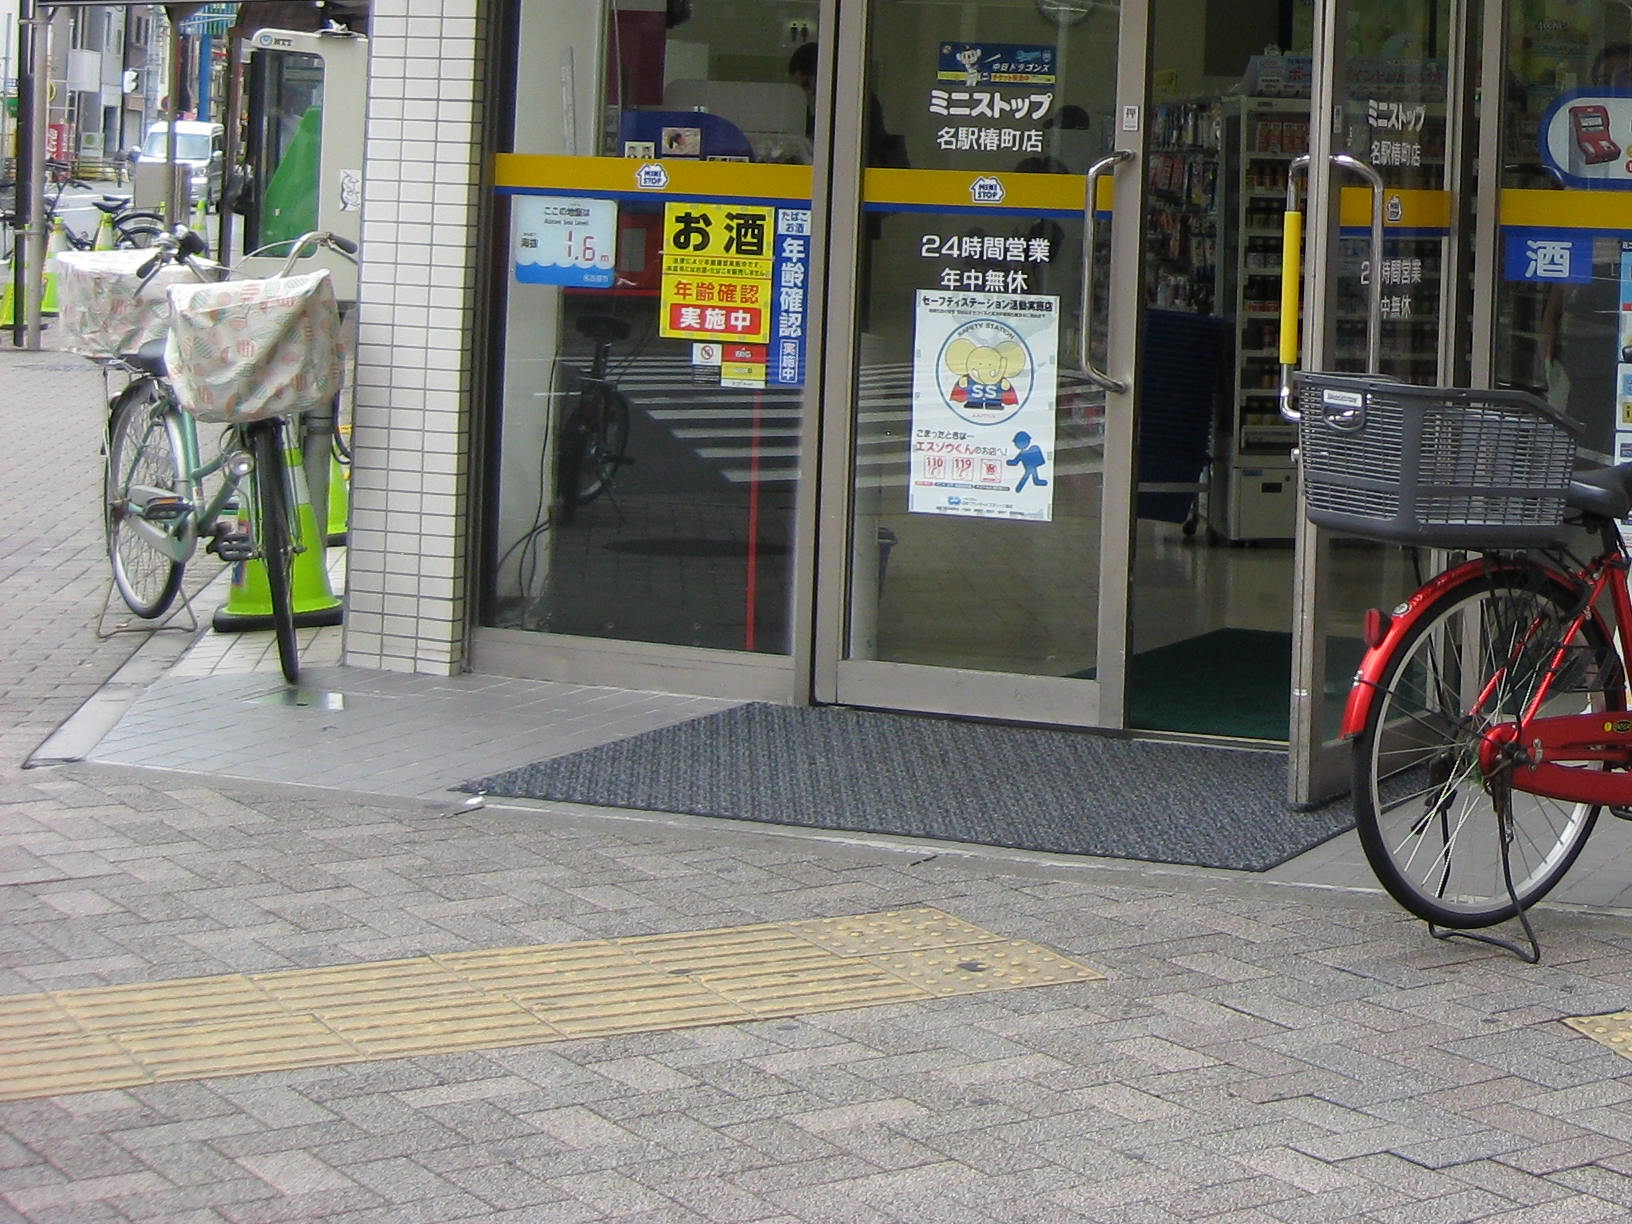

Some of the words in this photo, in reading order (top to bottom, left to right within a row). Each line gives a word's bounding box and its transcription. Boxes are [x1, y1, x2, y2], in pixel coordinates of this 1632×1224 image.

[929, 89, 1053, 120] ミニストップ
[1368, 99, 1426, 132] ミニストップ
[937, 127, 1044, 153] 名駅椿町店
[977, 191, 998, 200] STOP
[567, 230, 596, 262] 1.6
[672, 211, 767, 256] お酒
[920, 234, 1051, 263] 24時間営業
[1525, 240, 1573, 278] 酒
[941, 268, 1029, 294] 年中無休
[1360, 258, 1422, 285] 2時間営業
[674, 280, 759, 304] 年齢確認
[779, 237, 805, 338] 年齢確認
[680, 306, 751, 331] 実施中
[971, 384, 998, 398] SS
[926, 457, 944, 467] 110
[954, 458, 972, 469] 119
